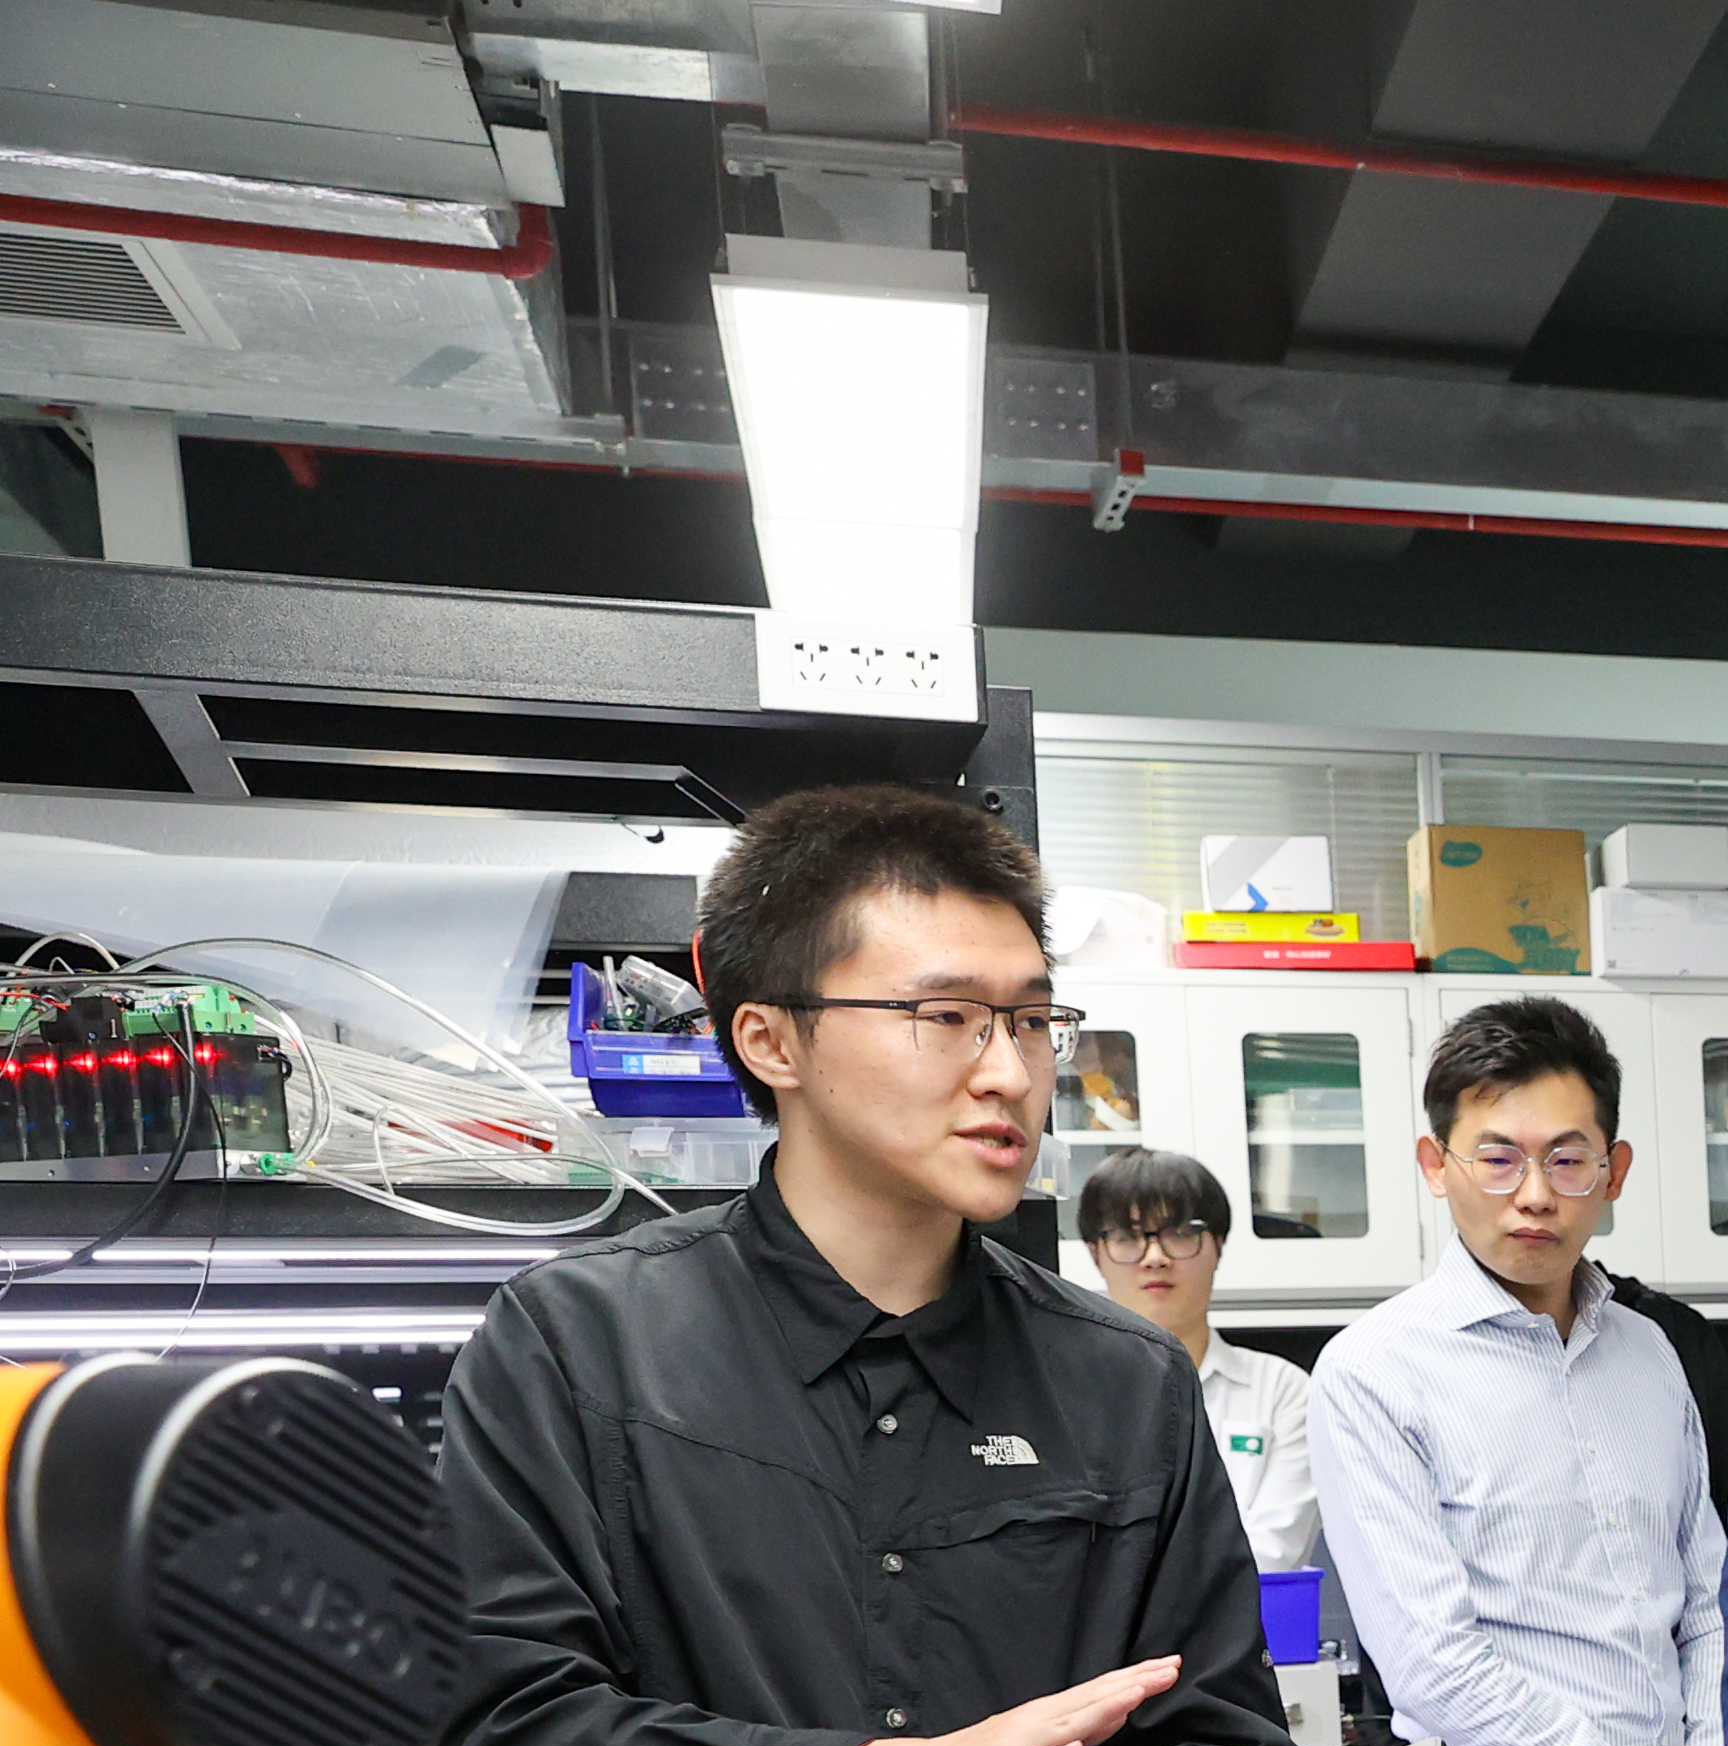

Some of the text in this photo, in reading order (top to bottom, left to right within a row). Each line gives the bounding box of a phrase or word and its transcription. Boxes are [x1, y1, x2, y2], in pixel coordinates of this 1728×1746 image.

[985, 1435, 1012, 1447] THE
[970, 1445, 1014, 1457] NORTH
[983, 1455, 1016, 1466] FACE
